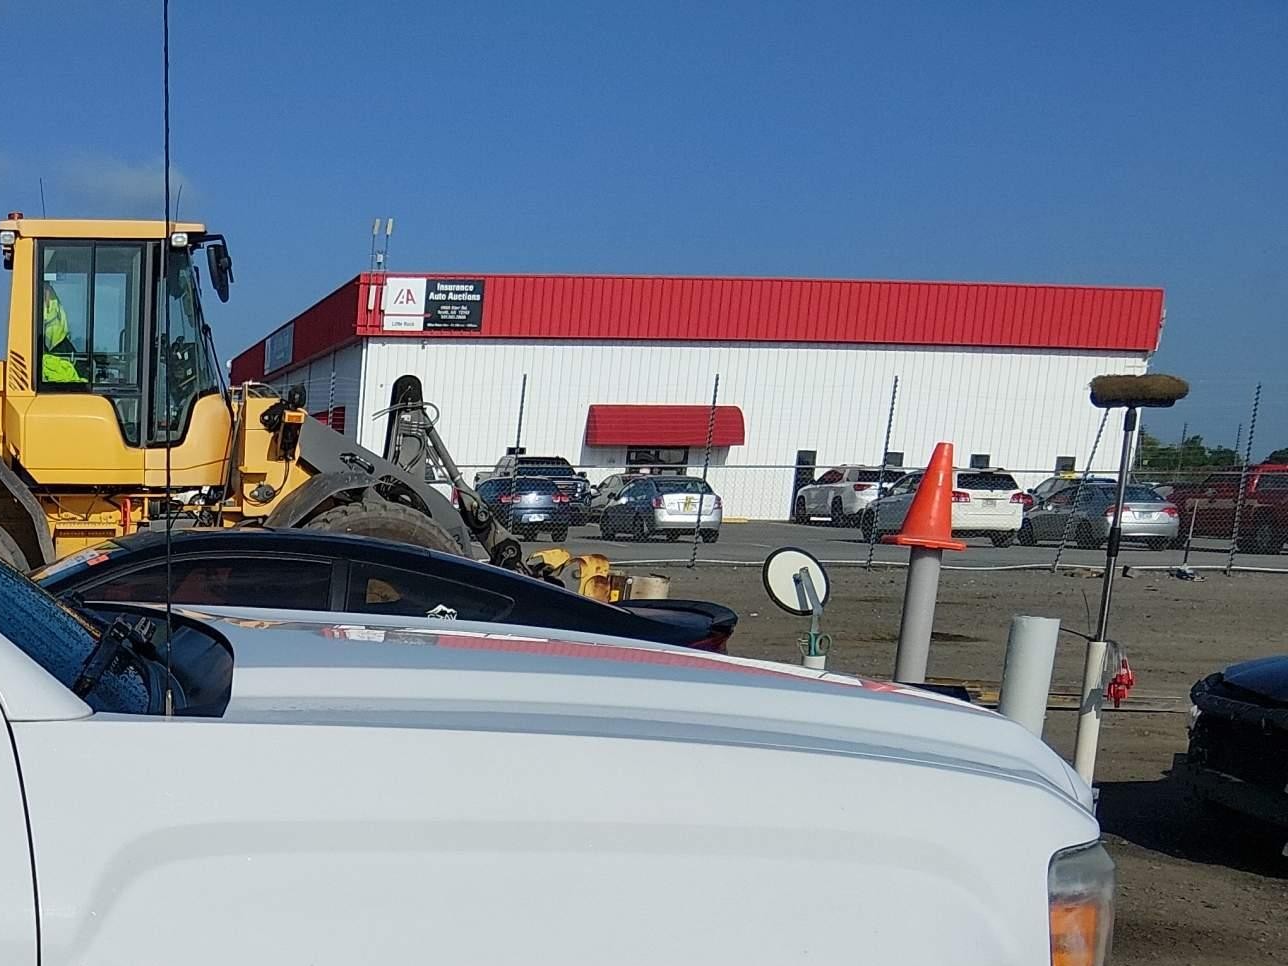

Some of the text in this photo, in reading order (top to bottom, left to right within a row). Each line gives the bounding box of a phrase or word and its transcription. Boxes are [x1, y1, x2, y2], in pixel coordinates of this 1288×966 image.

[436, 282, 474, 292] Insurance
[428, 291, 481, 302] Auto Auctions
